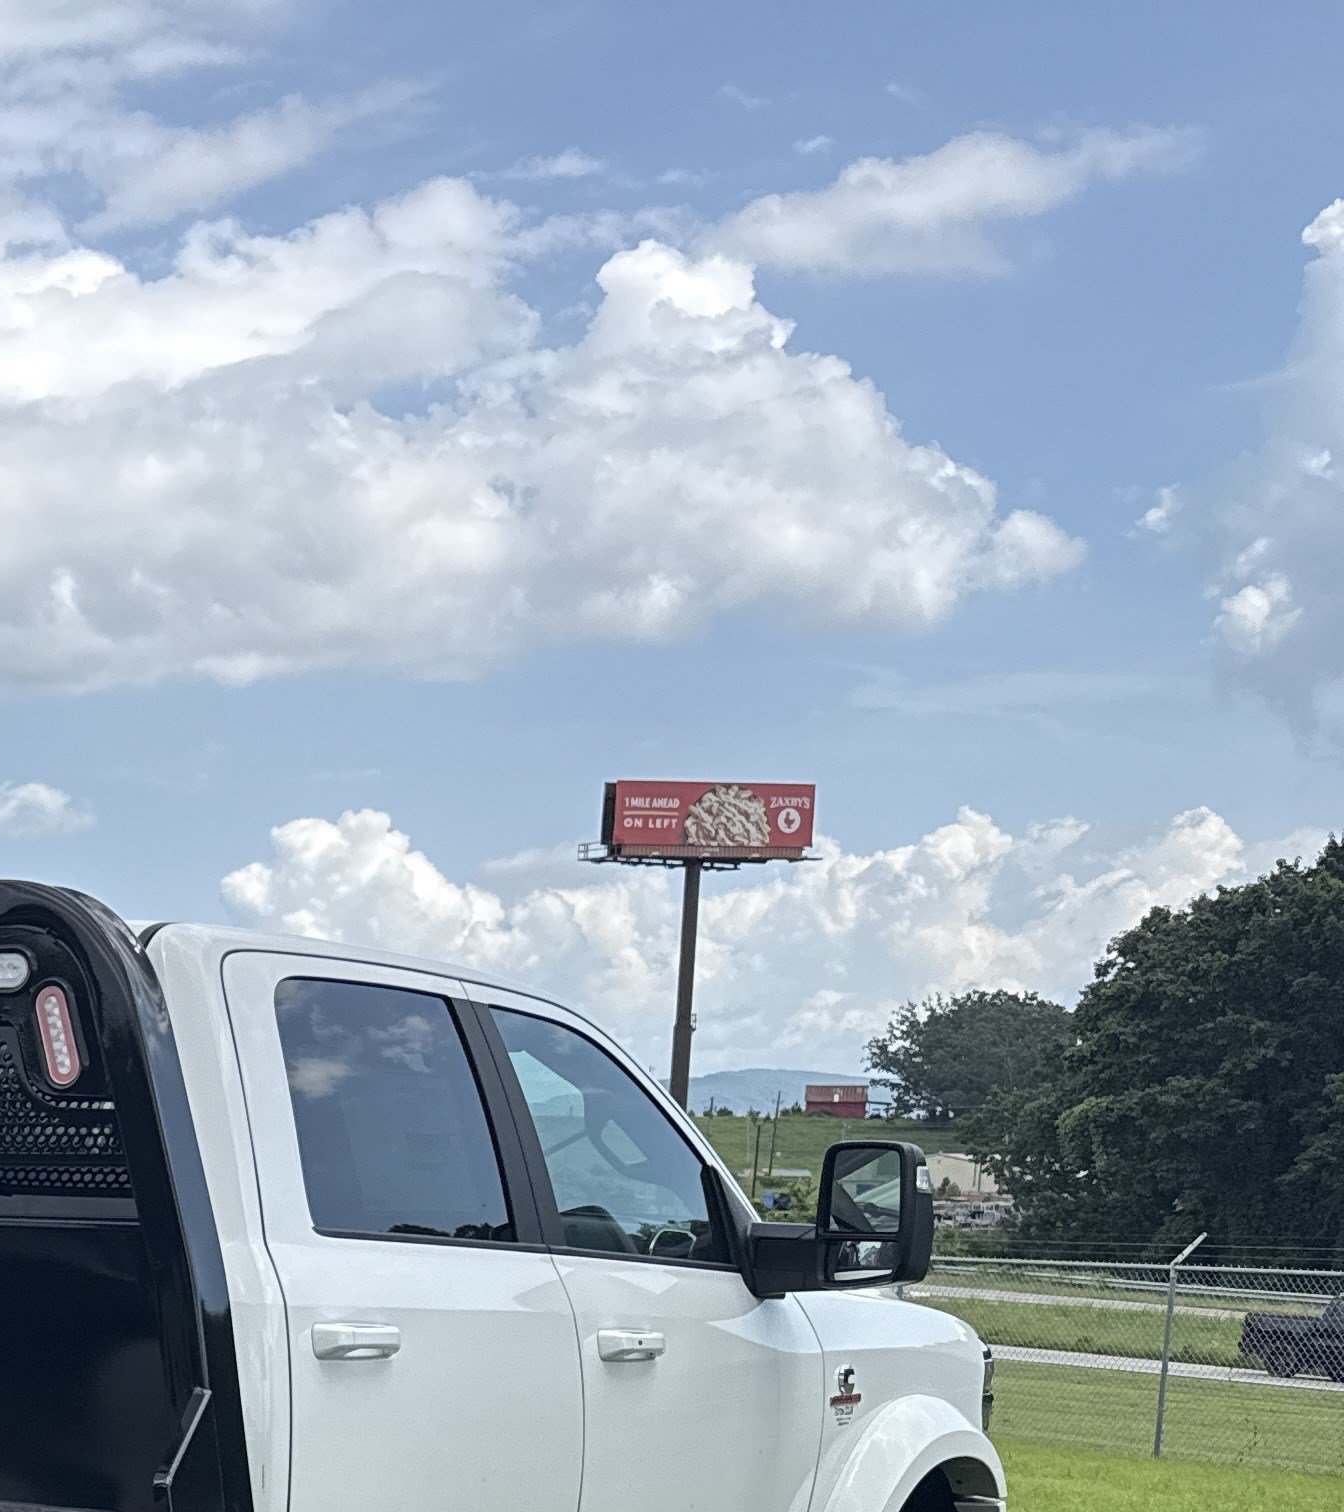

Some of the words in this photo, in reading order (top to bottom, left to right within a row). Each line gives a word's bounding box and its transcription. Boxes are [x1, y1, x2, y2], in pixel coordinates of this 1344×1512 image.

[630, 797, 651, 808] MILE
[651, 797, 680, 809] AHEAD
[769, 796, 811, 809] ZAXBY'S
[623, 817, 643, 828] ON
[648, 817, 678, 829] LEFT
